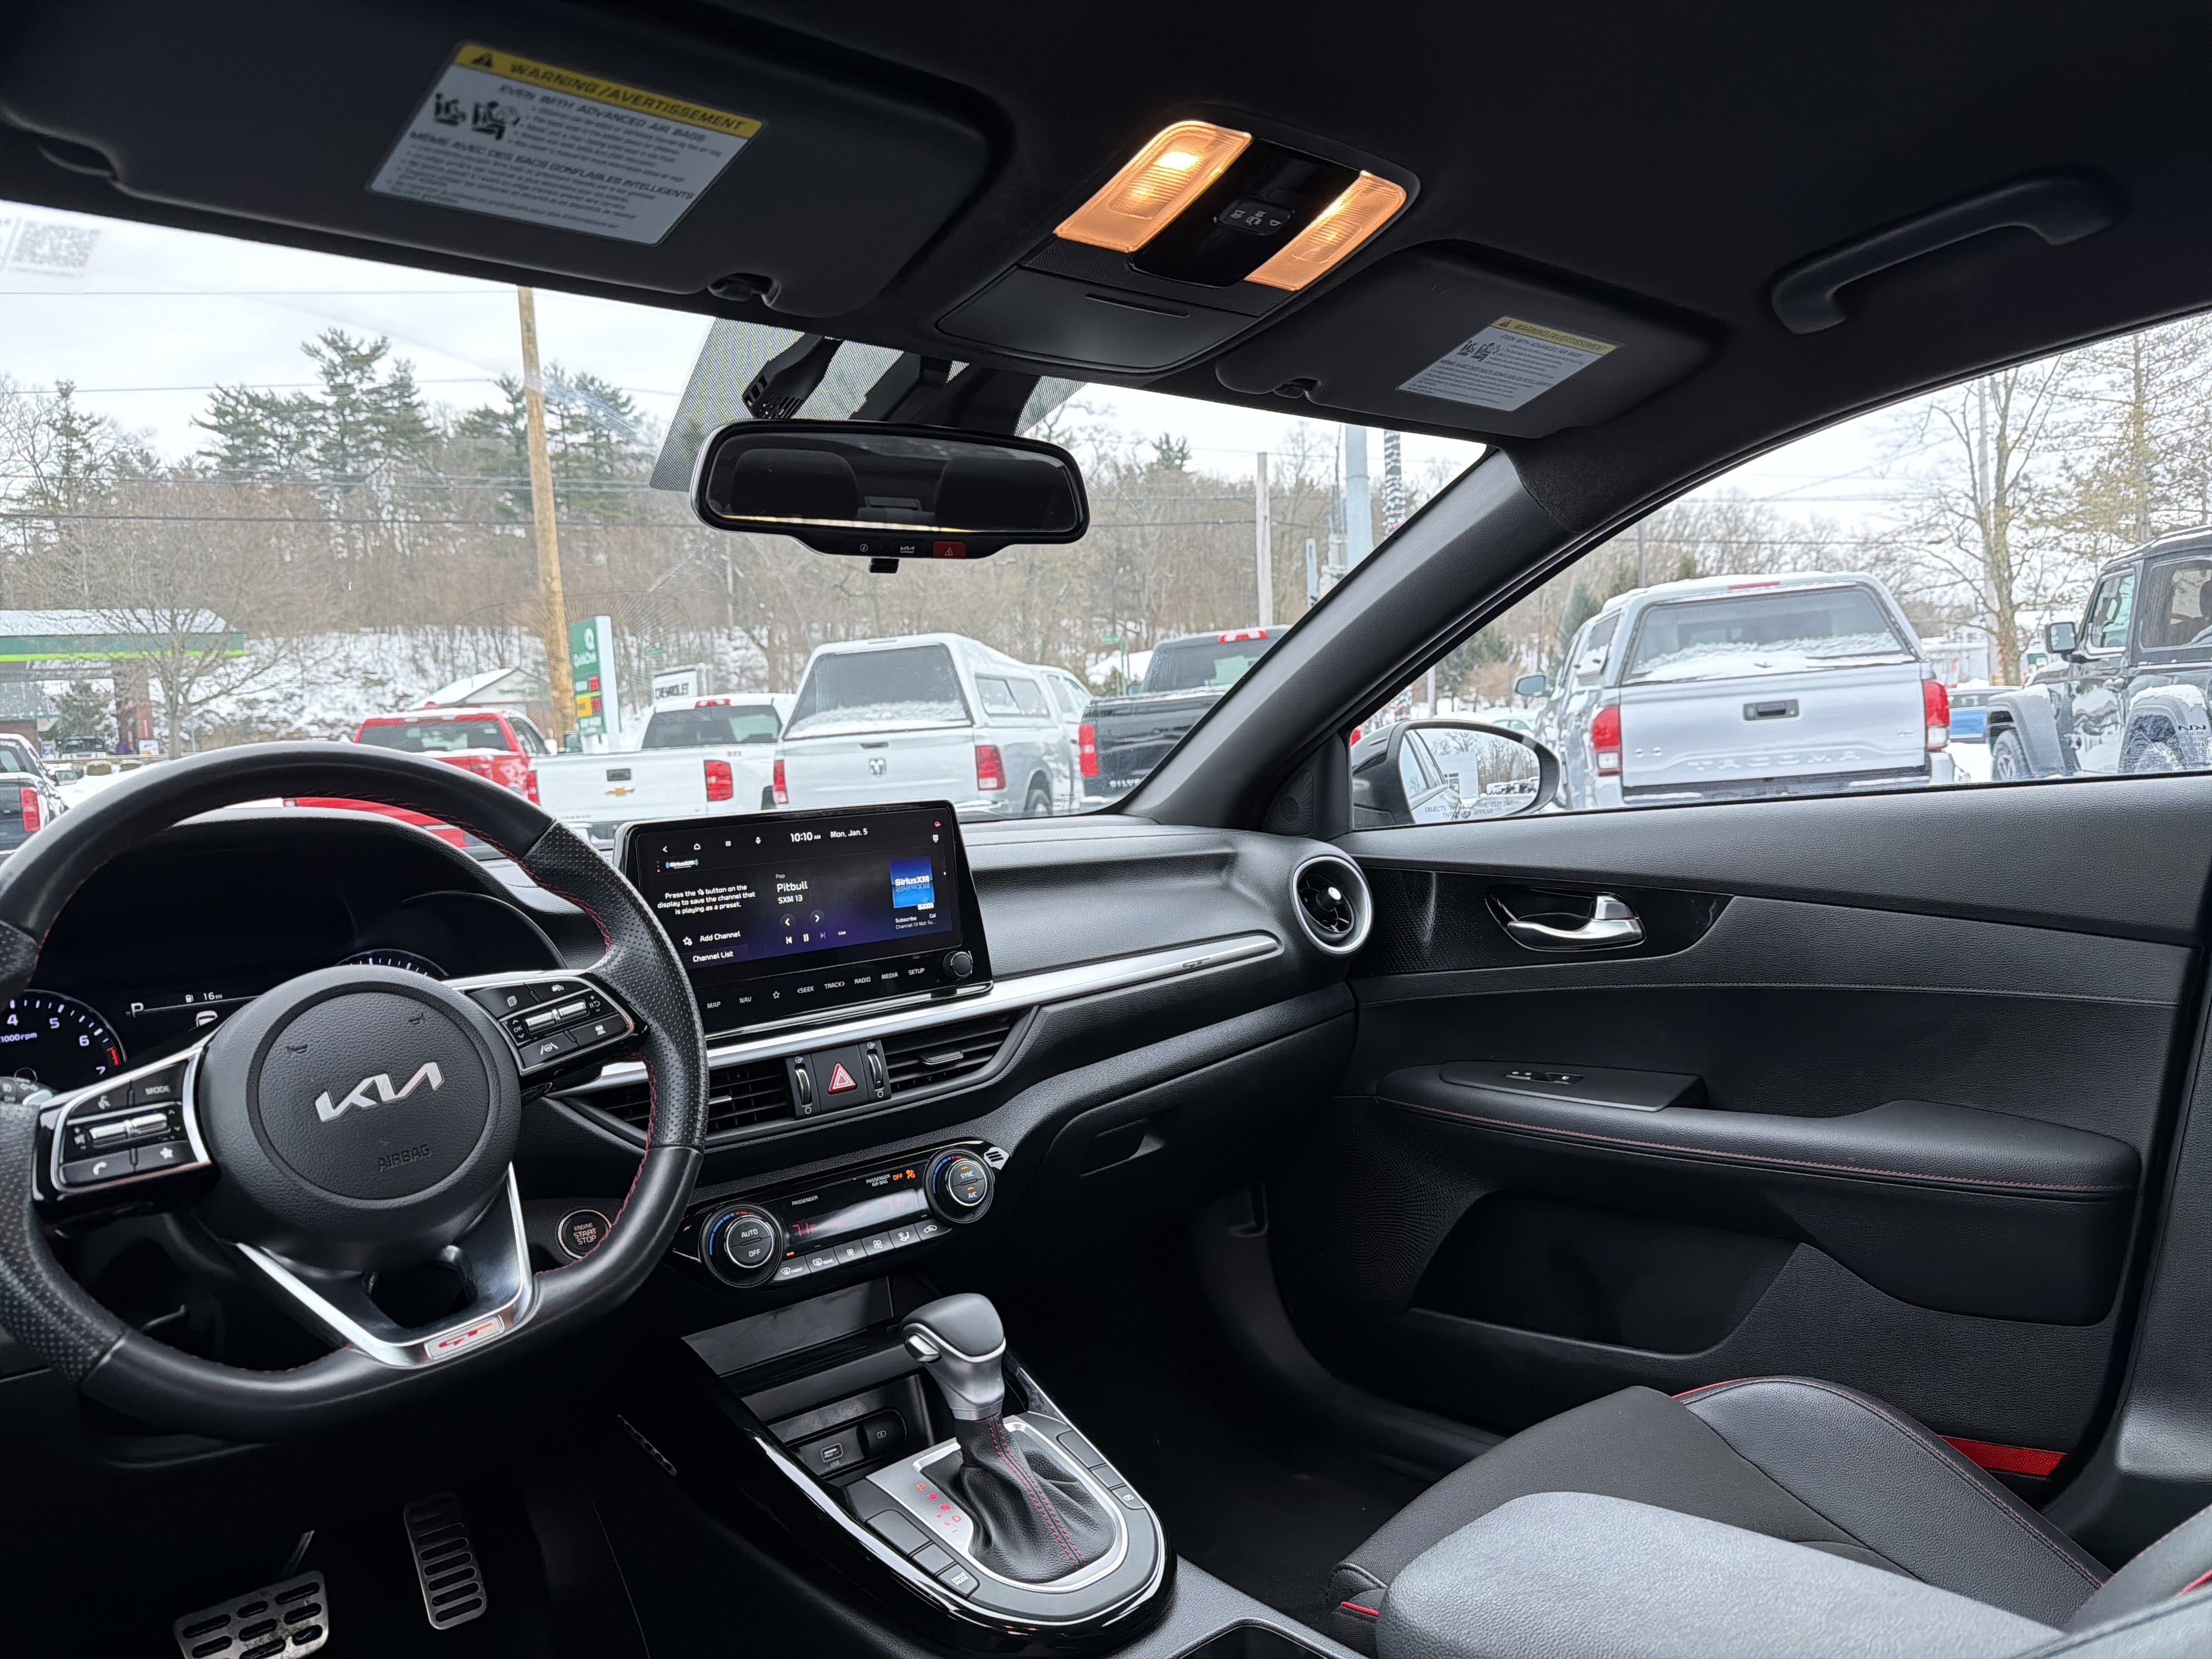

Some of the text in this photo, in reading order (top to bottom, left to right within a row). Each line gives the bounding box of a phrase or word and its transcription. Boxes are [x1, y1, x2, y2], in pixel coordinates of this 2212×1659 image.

[575, 104, 648, 127] ADVANCED
[648, 121, 673, 133] AIR
[672, 128, 708, 142] BAGS
[620, 178, 696, 200] INTELLIGENTS
[791, 832, 813, 842] 10:10
[895, 875, 930, 887] SiriusXM
[706, 887, 727, 895] button
[776, 881, 808, 893] Pitbull
[657, 900, 680, 909] display
[718, 893, 742, 902] channel
[778, 896, 794, 904] SXM
[682, 906, 705, 915] playing
[719, 902, 742, 911] preset.
[917, 902, 934, 911] sxm
[699, 930, 741, 943] Add Channel
[692, 950, 734, 963] Channel List
[881, 972, 899, 980] MEDIA
[908, 967, 925, 975] SETUP
[707, 1001, 721, 1009] MAP
[739, 996, 752, 1004] NAV
[131, 1002, 144, 1018] P
[7, 1014, 19, 1026] 4
[49, 1017, 60, 1029] 5
[79, 1035, 89, 1046] 6
[95, 1065, 106, 1075] 7
[145, 1085, 171, 1096] MODE
[315, 1061, 444, 1122] KIA
[379, 1143, 431, 1173] AIRBAG
[866, 1172, 904, 1184] PASSENGER OFF
[791, 1195, 819, 1206] PASSENGER
[573, 1222, 594, 1231] ENGINE
[573, 1228, 597, 1239] START
[741, 1228, 758, 1238] AUTO
[577, 1234, 597, 1245] STOP
[748, 1248, 761, 1257] OFF
[950, 1571, 967, 1583] DRIVE
[955, 1576, 969, 1587] MODE
